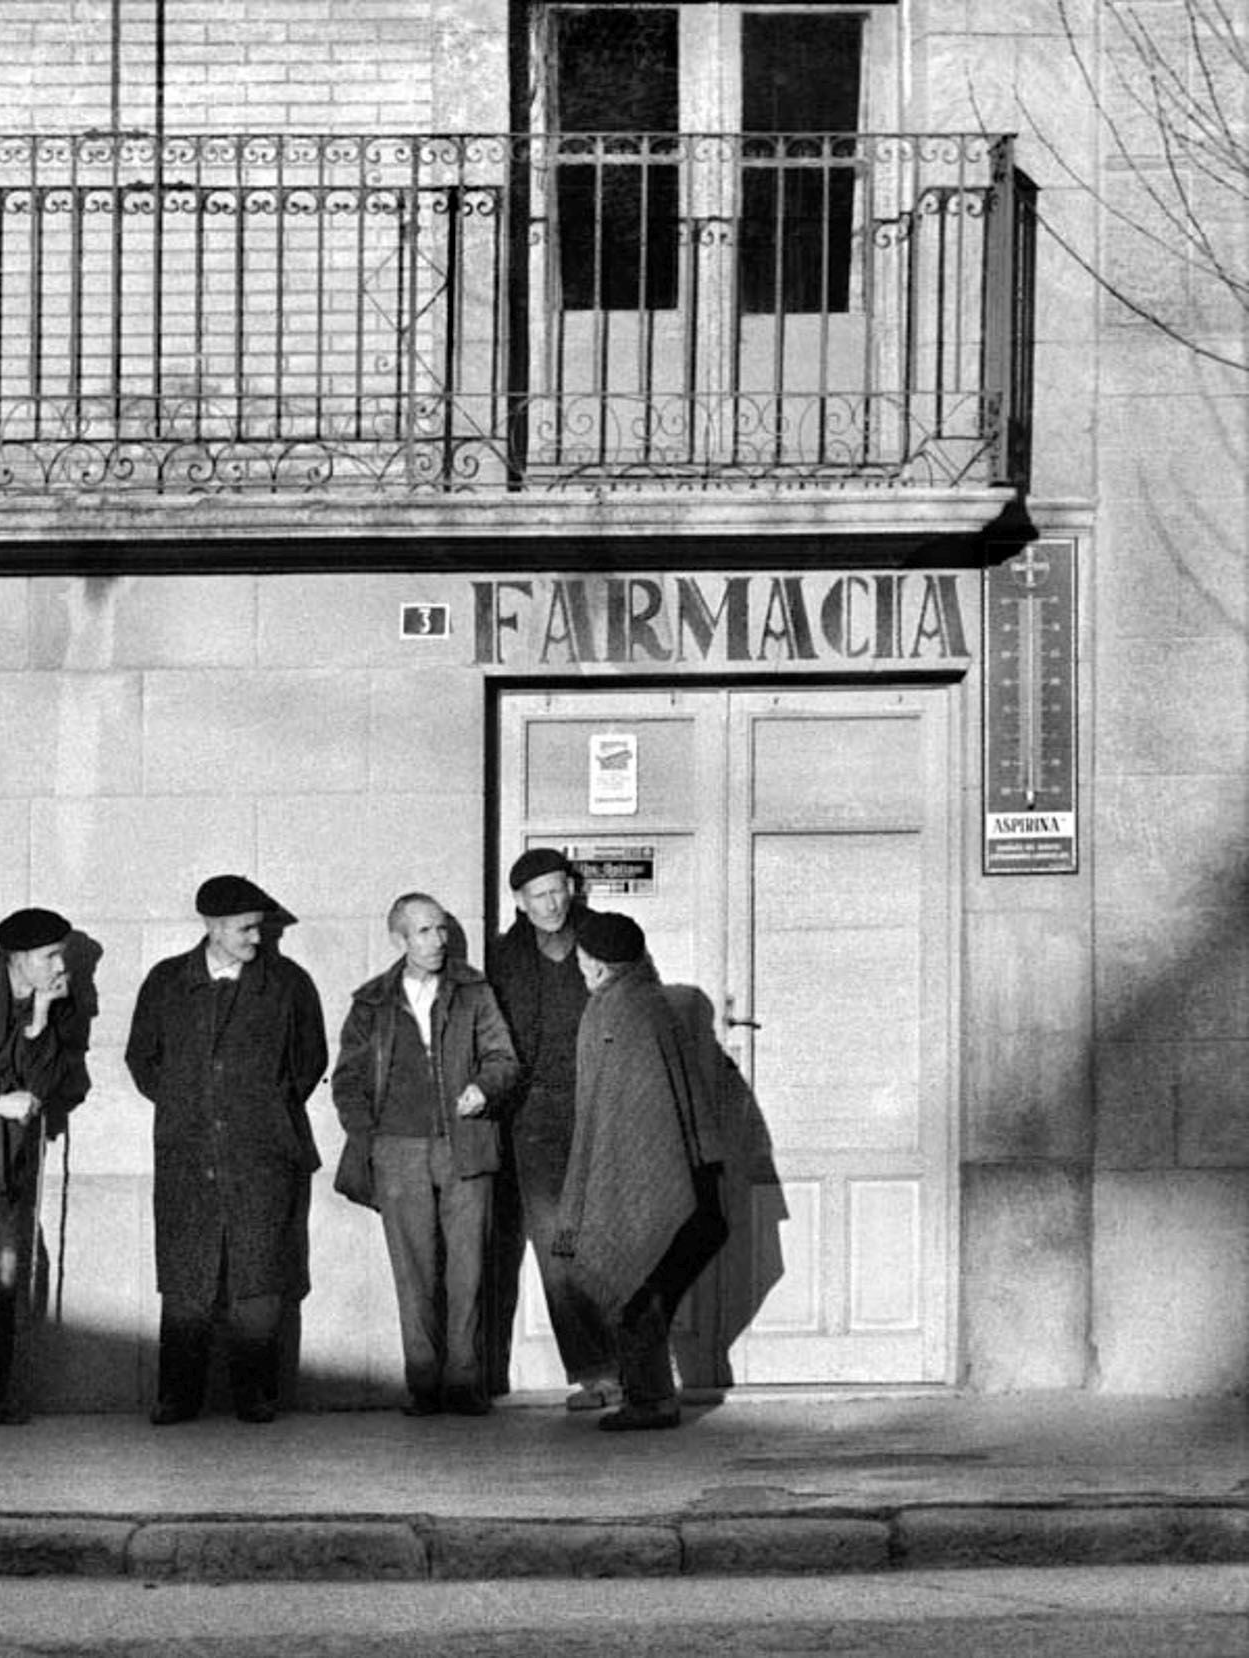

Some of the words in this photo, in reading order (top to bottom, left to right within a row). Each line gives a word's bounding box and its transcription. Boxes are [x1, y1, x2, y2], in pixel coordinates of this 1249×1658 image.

[418, 608, 432, 634] 3
[470, 574, 972, 664] FARMACIA
[993, 817, 1060, 833] ASPIRINA
